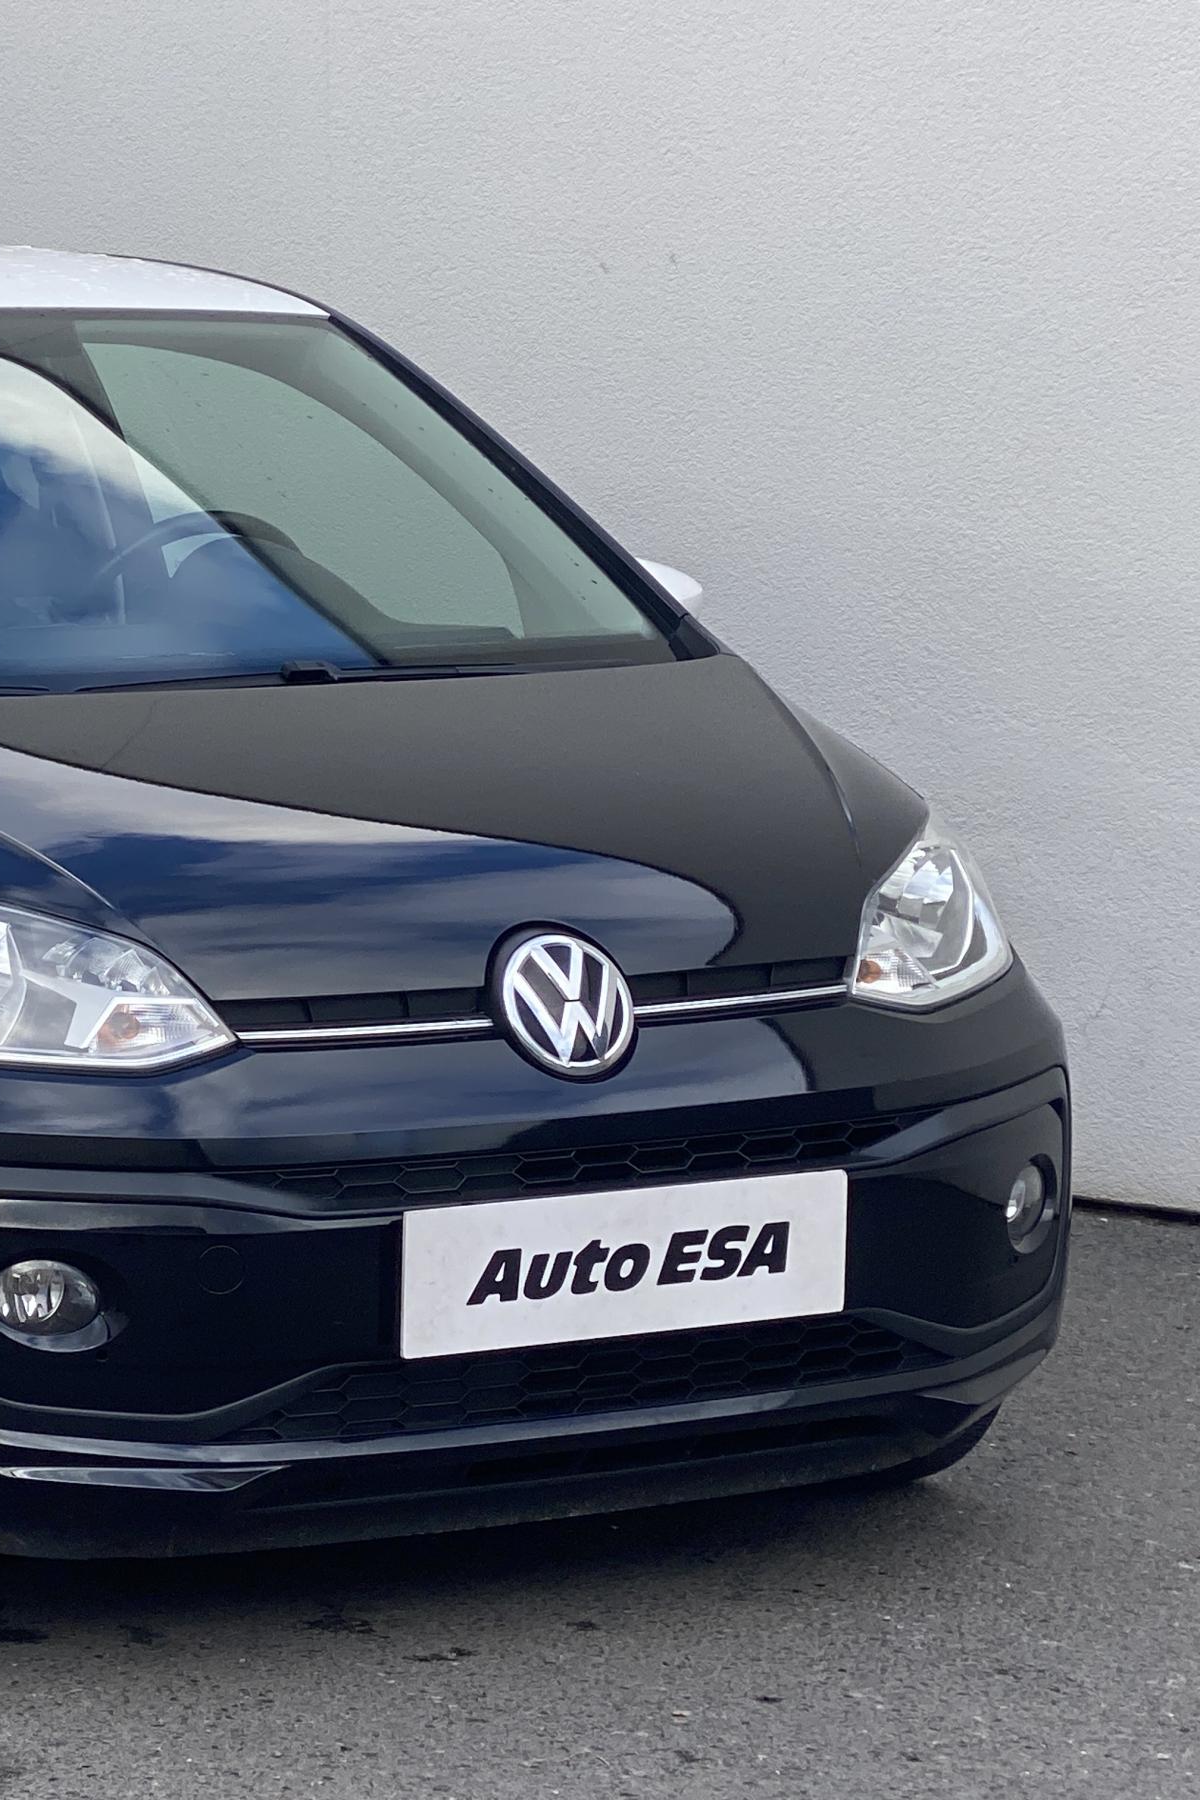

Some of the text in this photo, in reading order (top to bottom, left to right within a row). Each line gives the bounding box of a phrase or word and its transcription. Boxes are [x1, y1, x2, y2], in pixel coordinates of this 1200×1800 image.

[506, 938, 627, 1067] VW
[465, 1221, 790, 1306] Auto ESA
